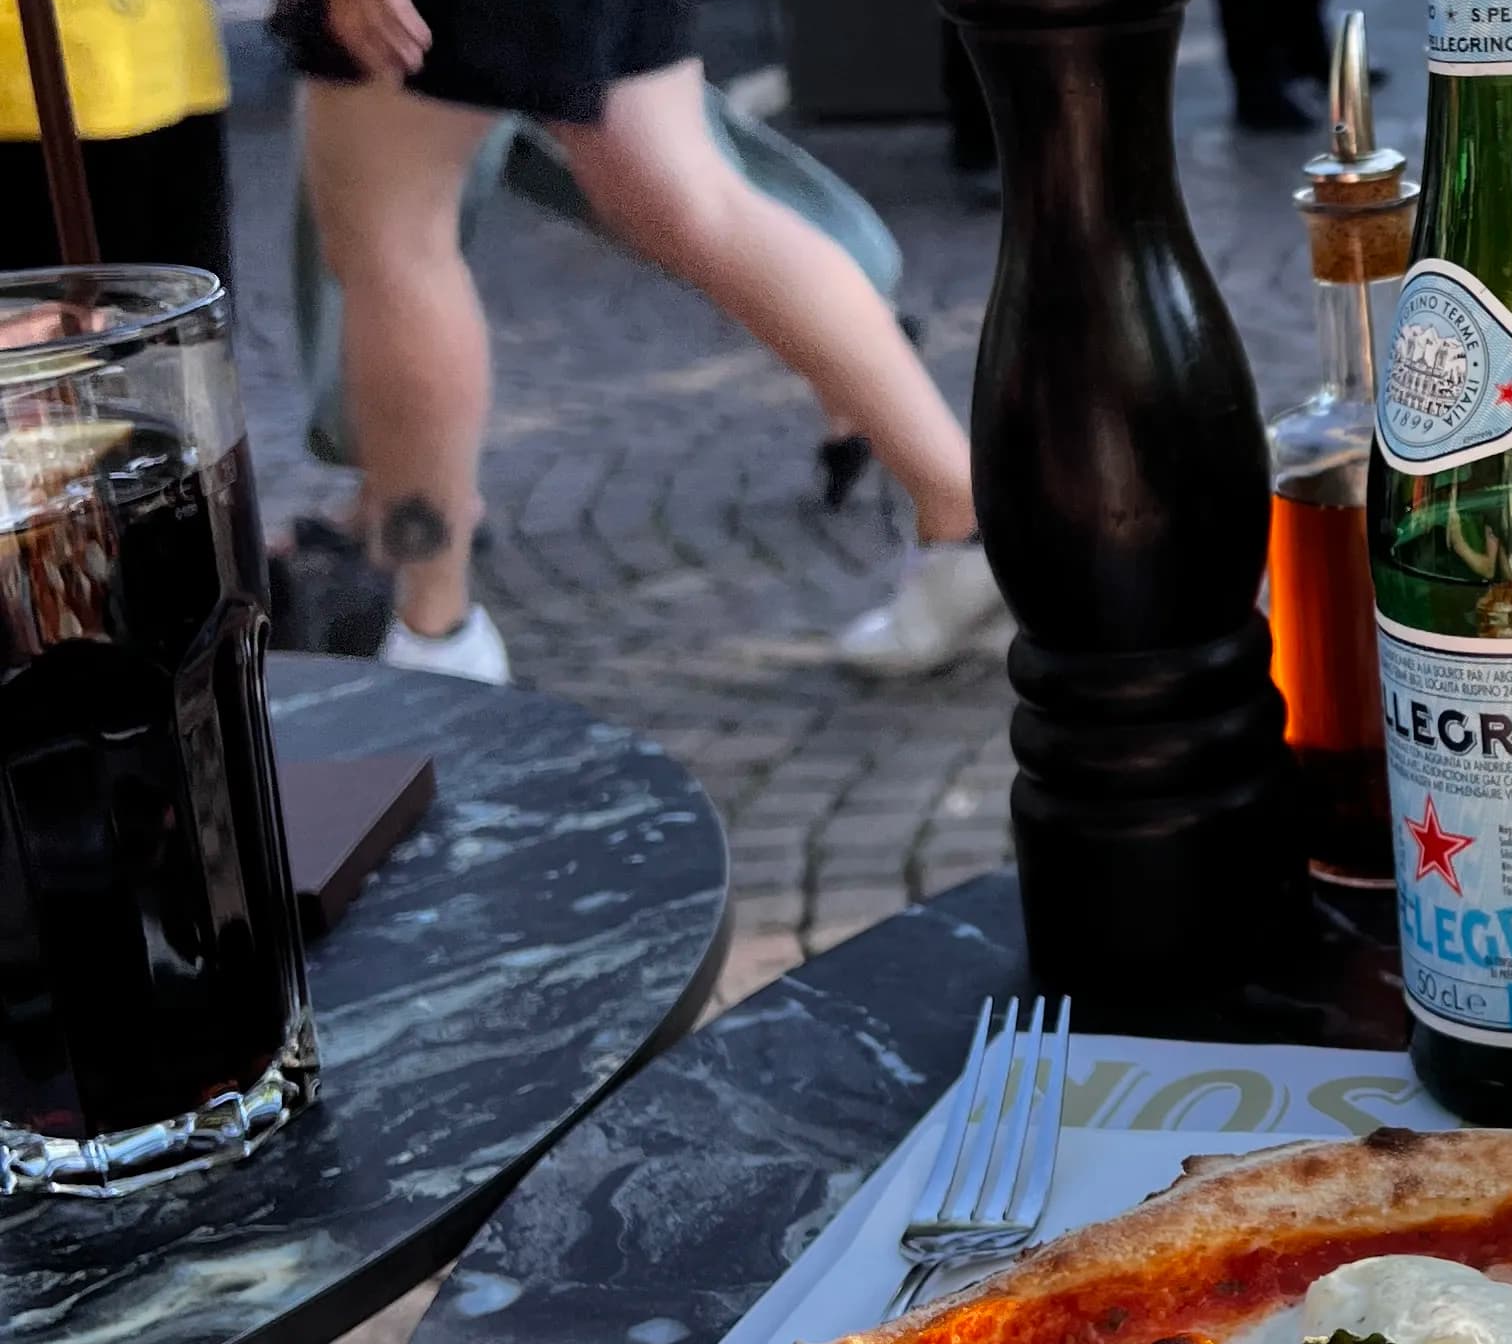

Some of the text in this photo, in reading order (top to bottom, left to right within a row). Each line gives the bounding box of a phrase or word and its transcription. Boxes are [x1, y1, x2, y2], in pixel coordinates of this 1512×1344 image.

[1442, 302, 1480, 352] TERME
[1391, 409, 1434, 434] 1899
[1442, 379, 1480, 428] ITALIA
[1417, 968, 1437, 1001] 50
